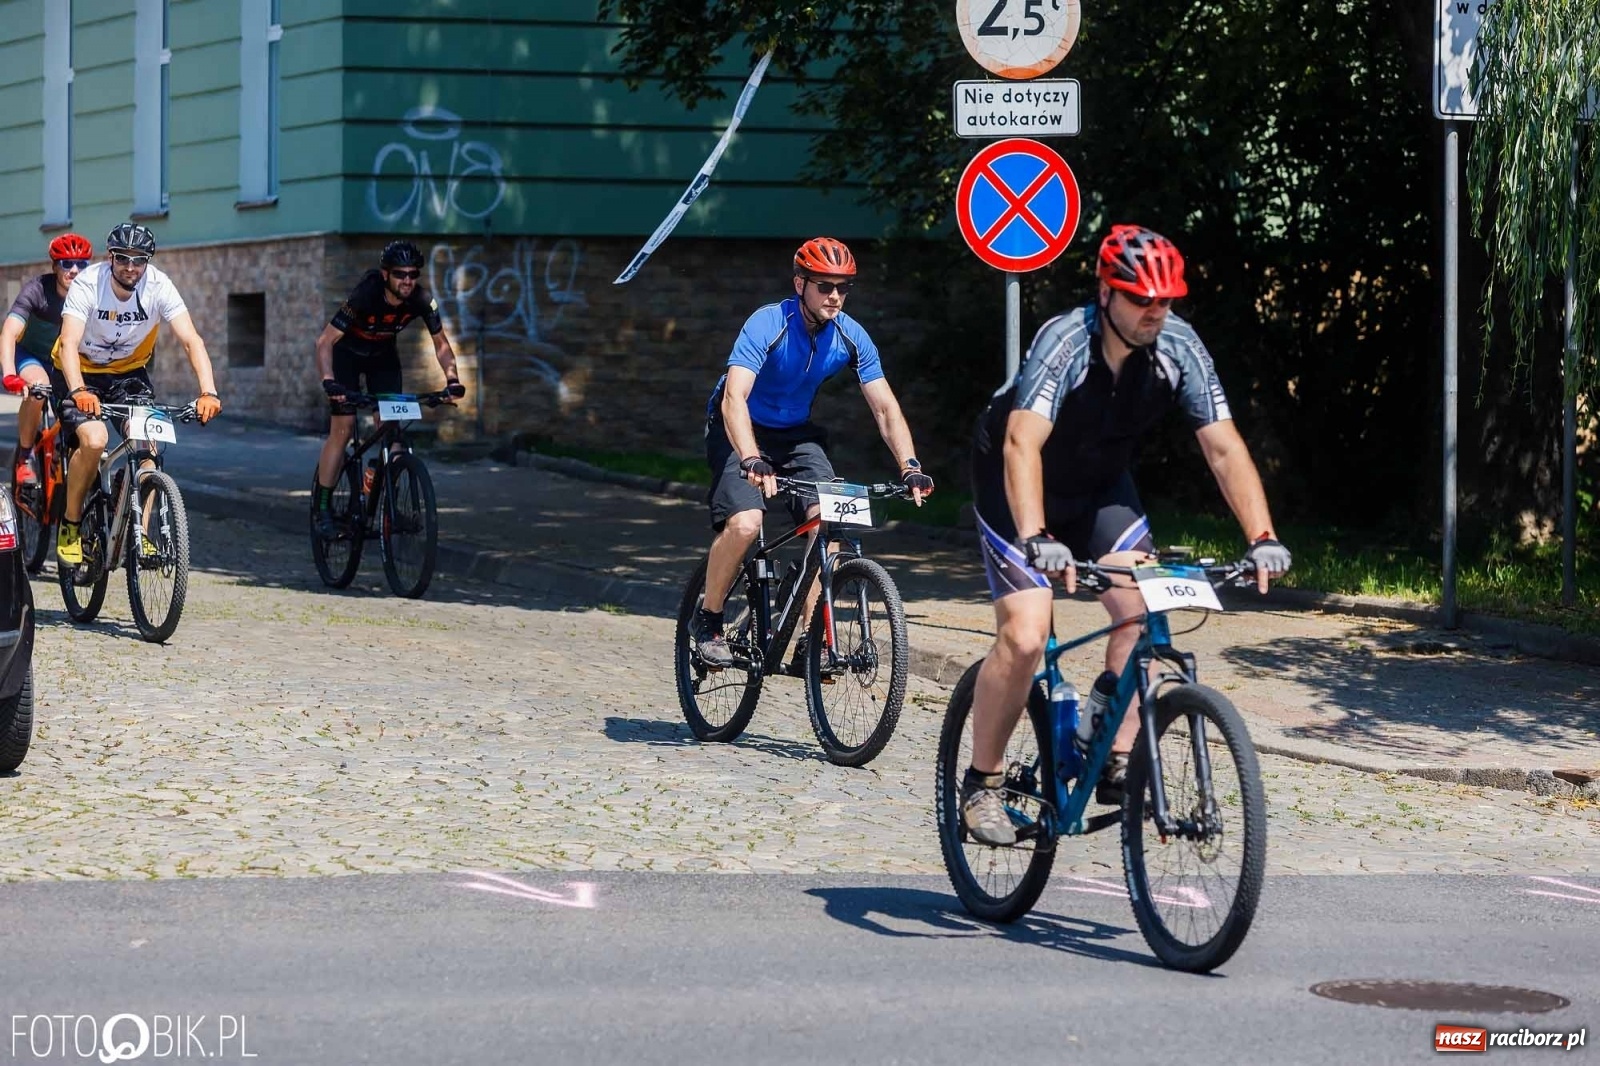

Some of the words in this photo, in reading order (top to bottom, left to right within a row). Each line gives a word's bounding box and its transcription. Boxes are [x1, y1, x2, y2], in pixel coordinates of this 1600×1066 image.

[977, 0, 1045, 41] 2,5
[964, 88, 994, 104] Nie
[1002, 88, 1070, 107] dotyczy
[966, 109, 1063, 126] autokarów
[390, 405, 409, 414] 126
[833, 501, 858, 515] 203
[1164, 584, 1197, 597] 160
